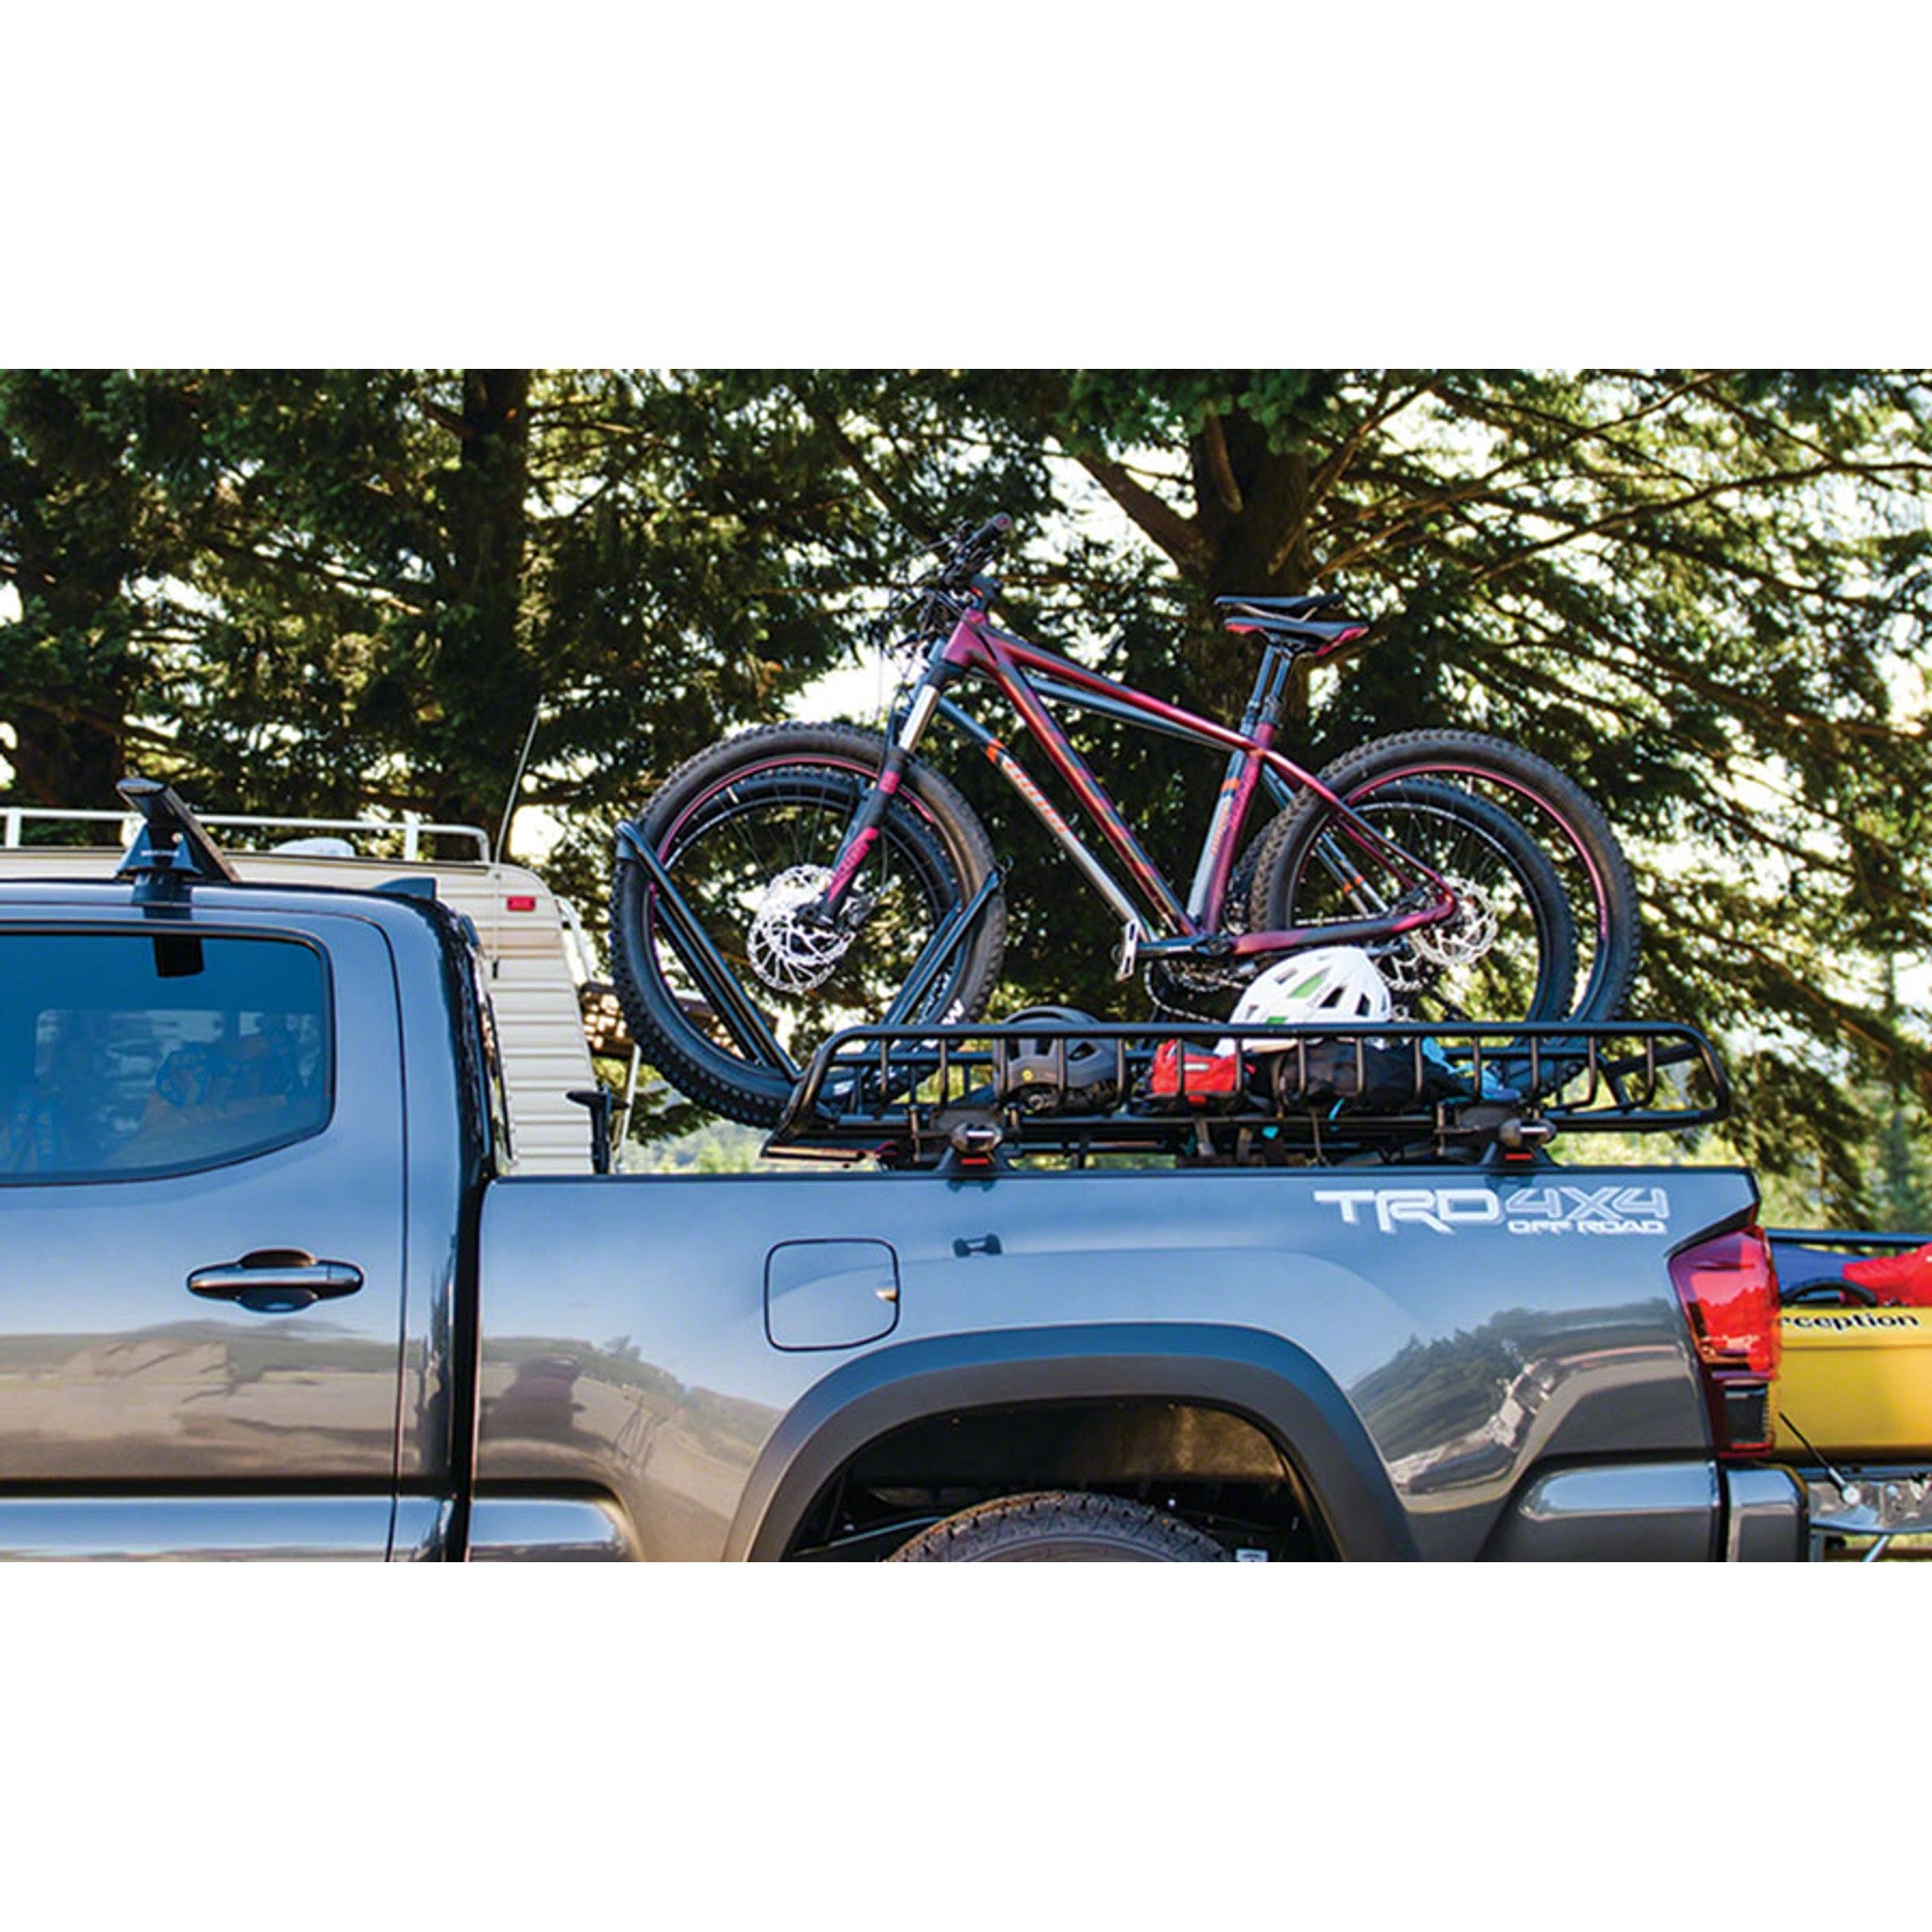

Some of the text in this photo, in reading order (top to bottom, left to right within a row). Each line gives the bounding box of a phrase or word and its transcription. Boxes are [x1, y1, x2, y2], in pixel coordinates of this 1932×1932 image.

[1314, 1187, 1670, 1234] TRD 4X4
[1507, 1220, 1668, 1235] OFF ROAD
